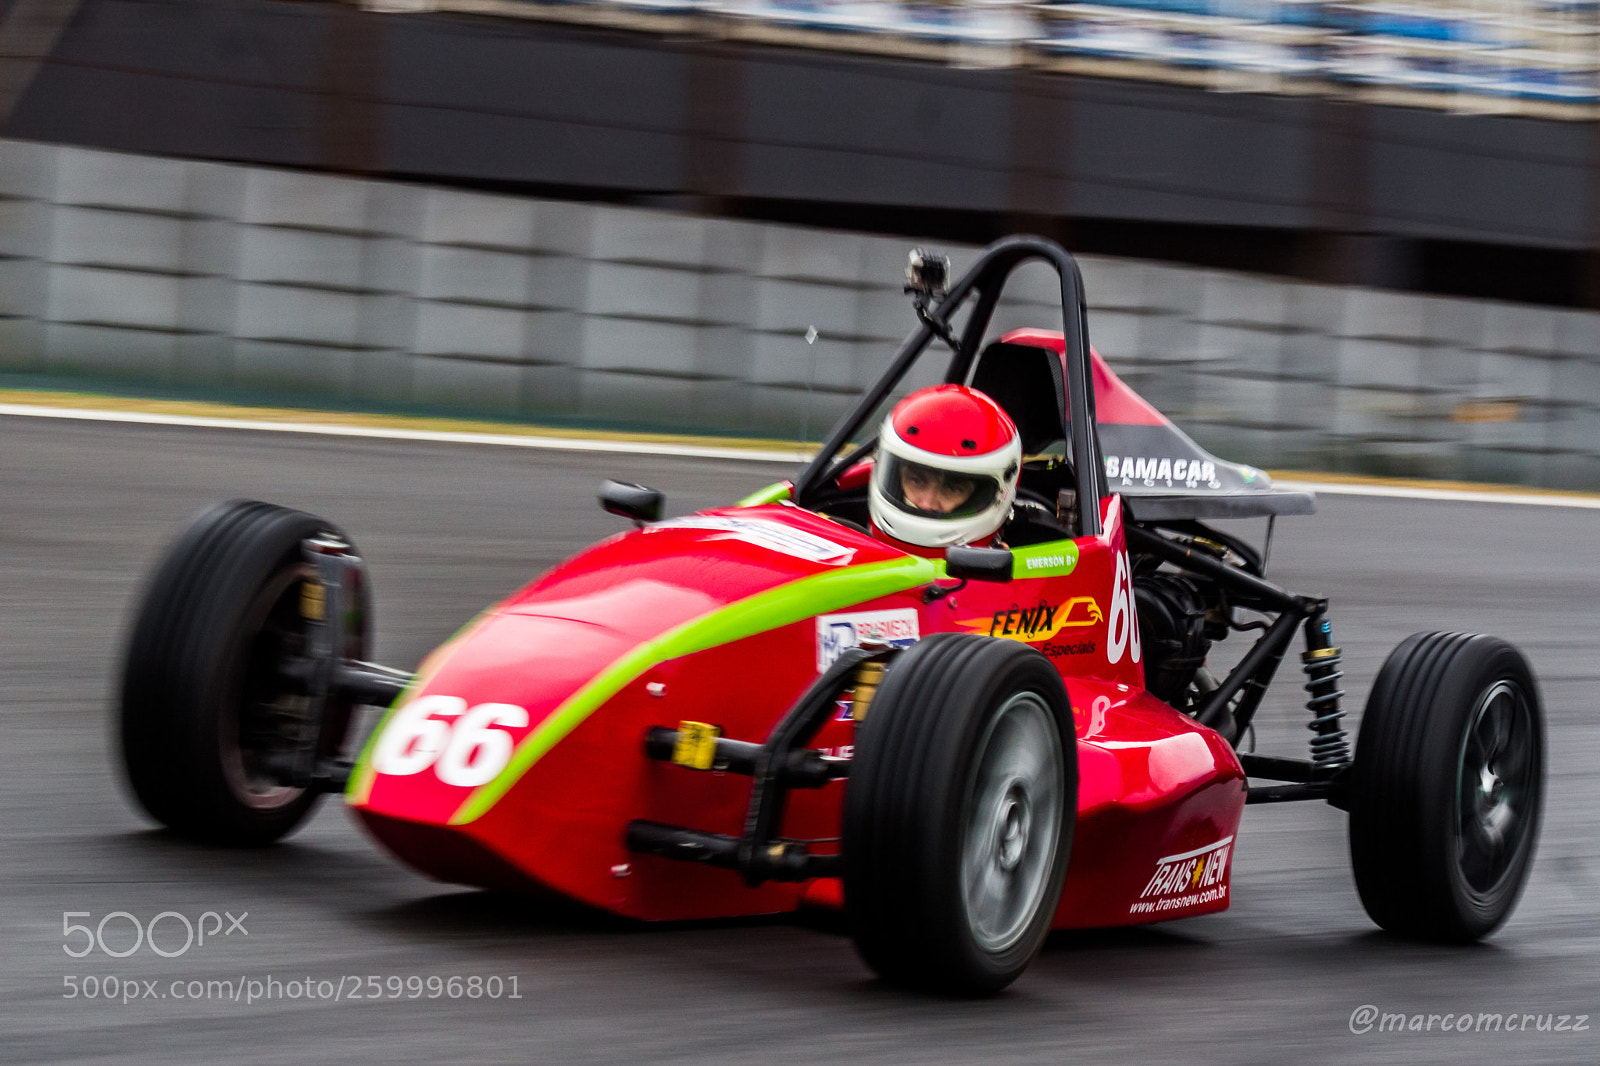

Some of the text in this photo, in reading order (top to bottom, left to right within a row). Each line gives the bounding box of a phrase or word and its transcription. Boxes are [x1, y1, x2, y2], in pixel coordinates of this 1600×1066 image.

[1026, 555, 1065, 569] EMERSON
[371, 695, 530, 787] 66
[1140, 845, 1230, 898] TRANS NEW
[1129, 883, 1227, 914] www.transnew.com.br
